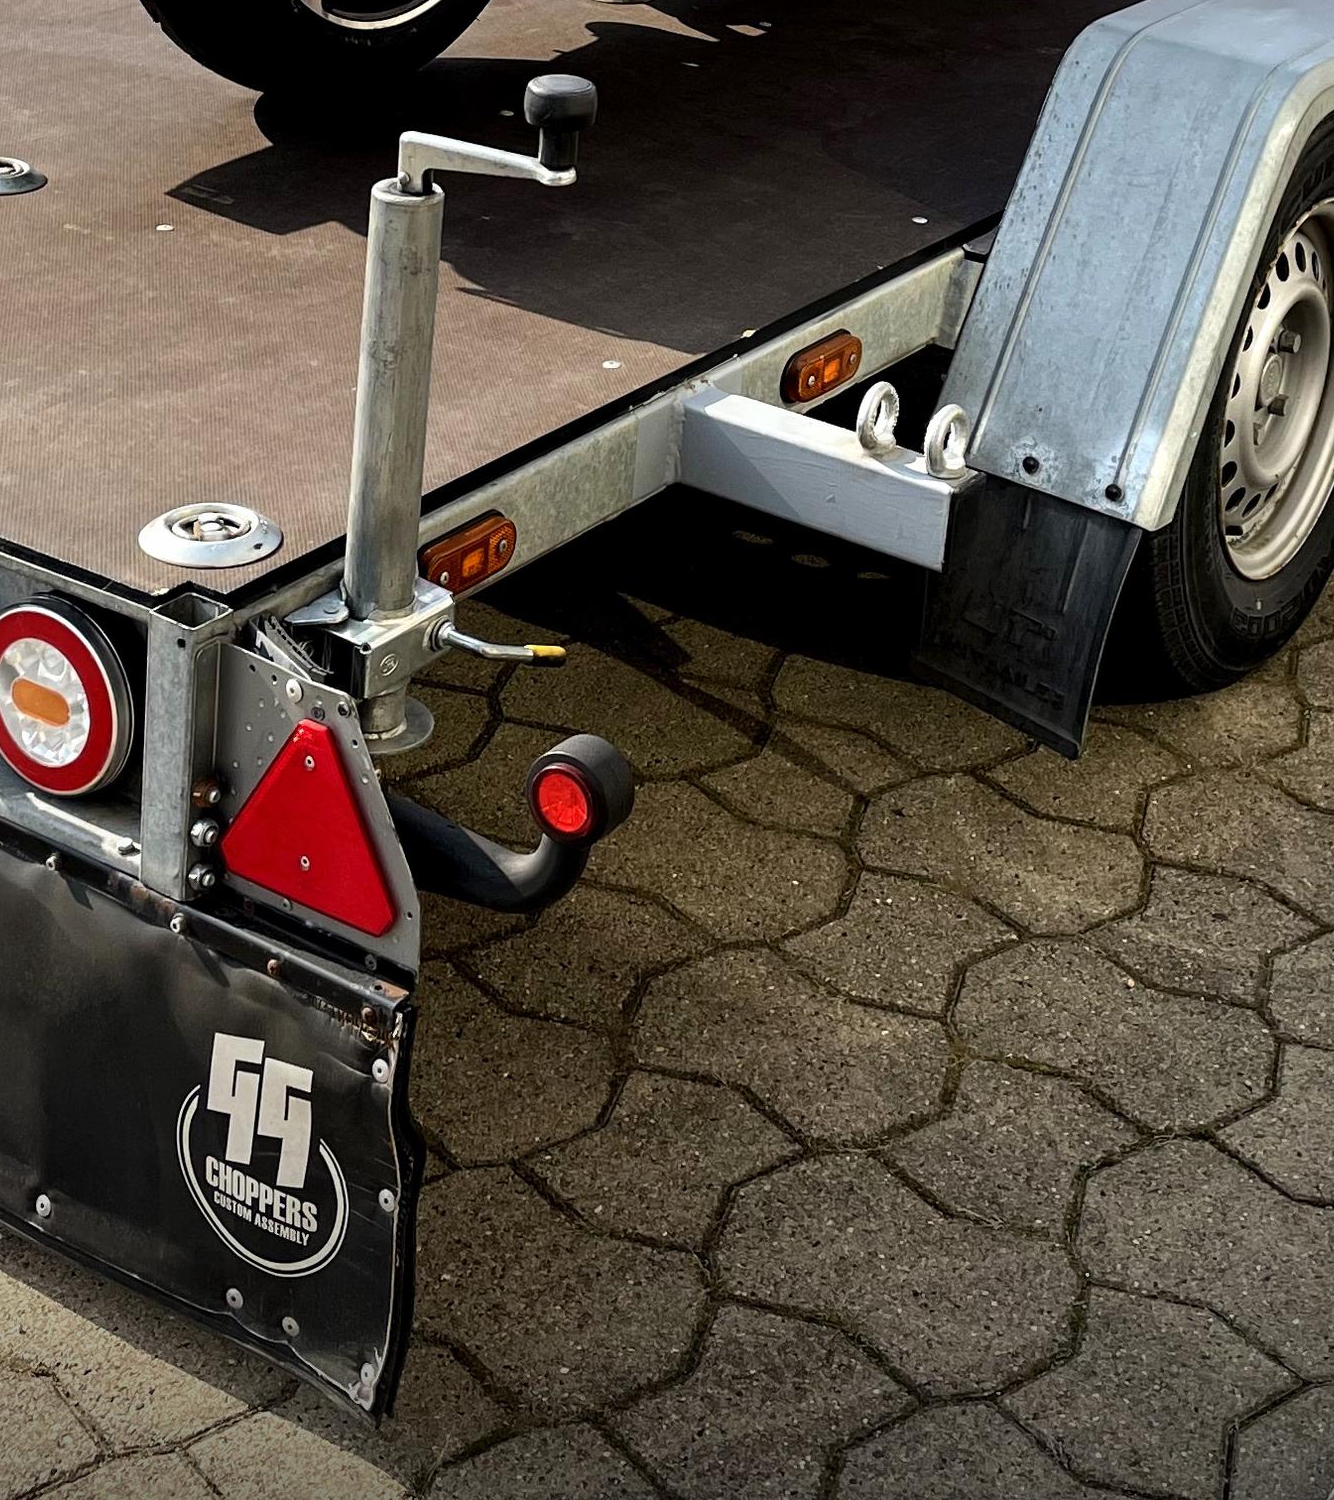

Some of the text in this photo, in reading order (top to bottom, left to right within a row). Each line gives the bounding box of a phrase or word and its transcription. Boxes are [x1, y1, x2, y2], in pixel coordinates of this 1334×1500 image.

[205, 1155, 318, 1232] CHOPPERS
[214, 1190, 310, 1247] CUSTOM ASSEMBLY
